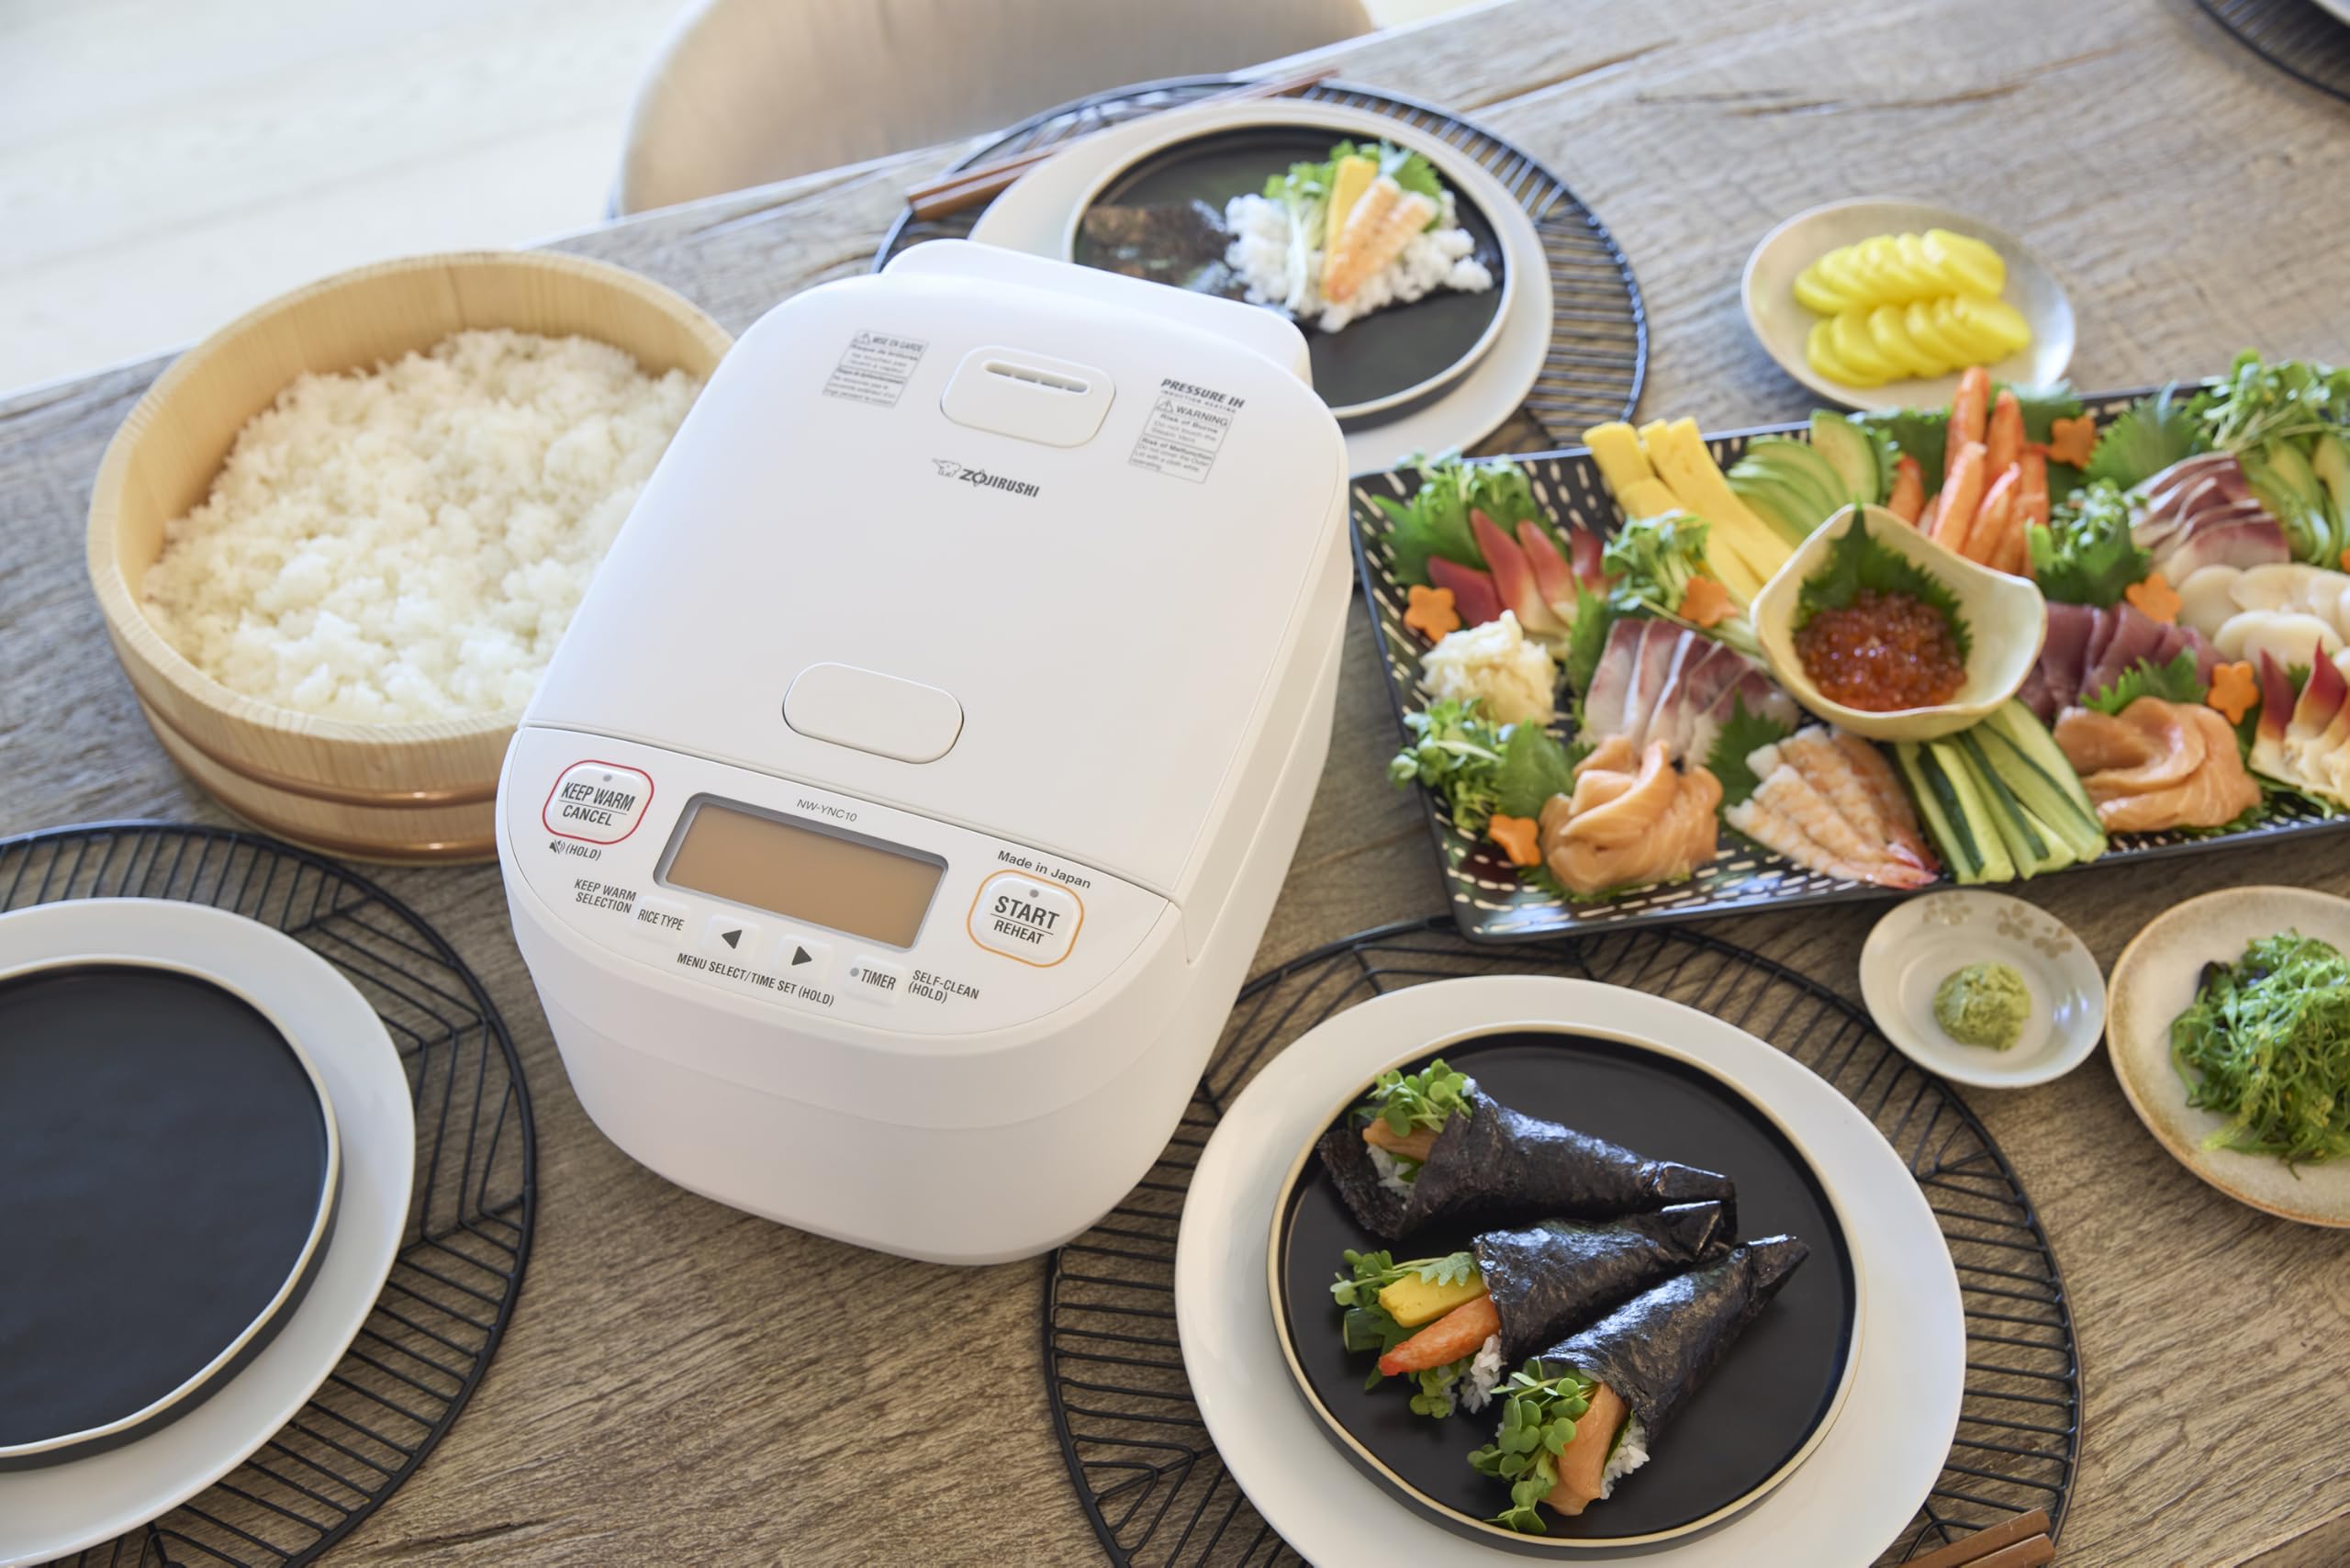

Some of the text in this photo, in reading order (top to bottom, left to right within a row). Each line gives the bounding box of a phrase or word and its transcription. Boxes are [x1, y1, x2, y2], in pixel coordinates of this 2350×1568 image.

[1160, 378, 1227, 403] PRESSURE
[1176, 405, 1228, 427] WARNING
[958, 468, 1040, 498] ZOJIRUSHI
[561, 781, 636, 812] KEEP WARM
[562, 804, 613, 827] CANCEL
[796, 798, 858, 823] NW-YNC10
[565, 844, 602, 861] (HOLD)
[997, 850, 1091, 890] Made in Japan
[574, 878, 637, 902] KEEP WARM
[576, 891, 632, 914] SELECTION
[637, 909, 685, 931] RICE TYPE
[994, 895, 1060, 930] START
[993, 919, 1045, 946] REHEAT
[677, 952, 834, 1007] MENU SELECT/TIME SET (HOLD)
[860, 969, 897, 991] TIMER
[912, 969, 980, 1000] SELF-CLEAN
[908, 982, 948, 1004] (HOLD)
